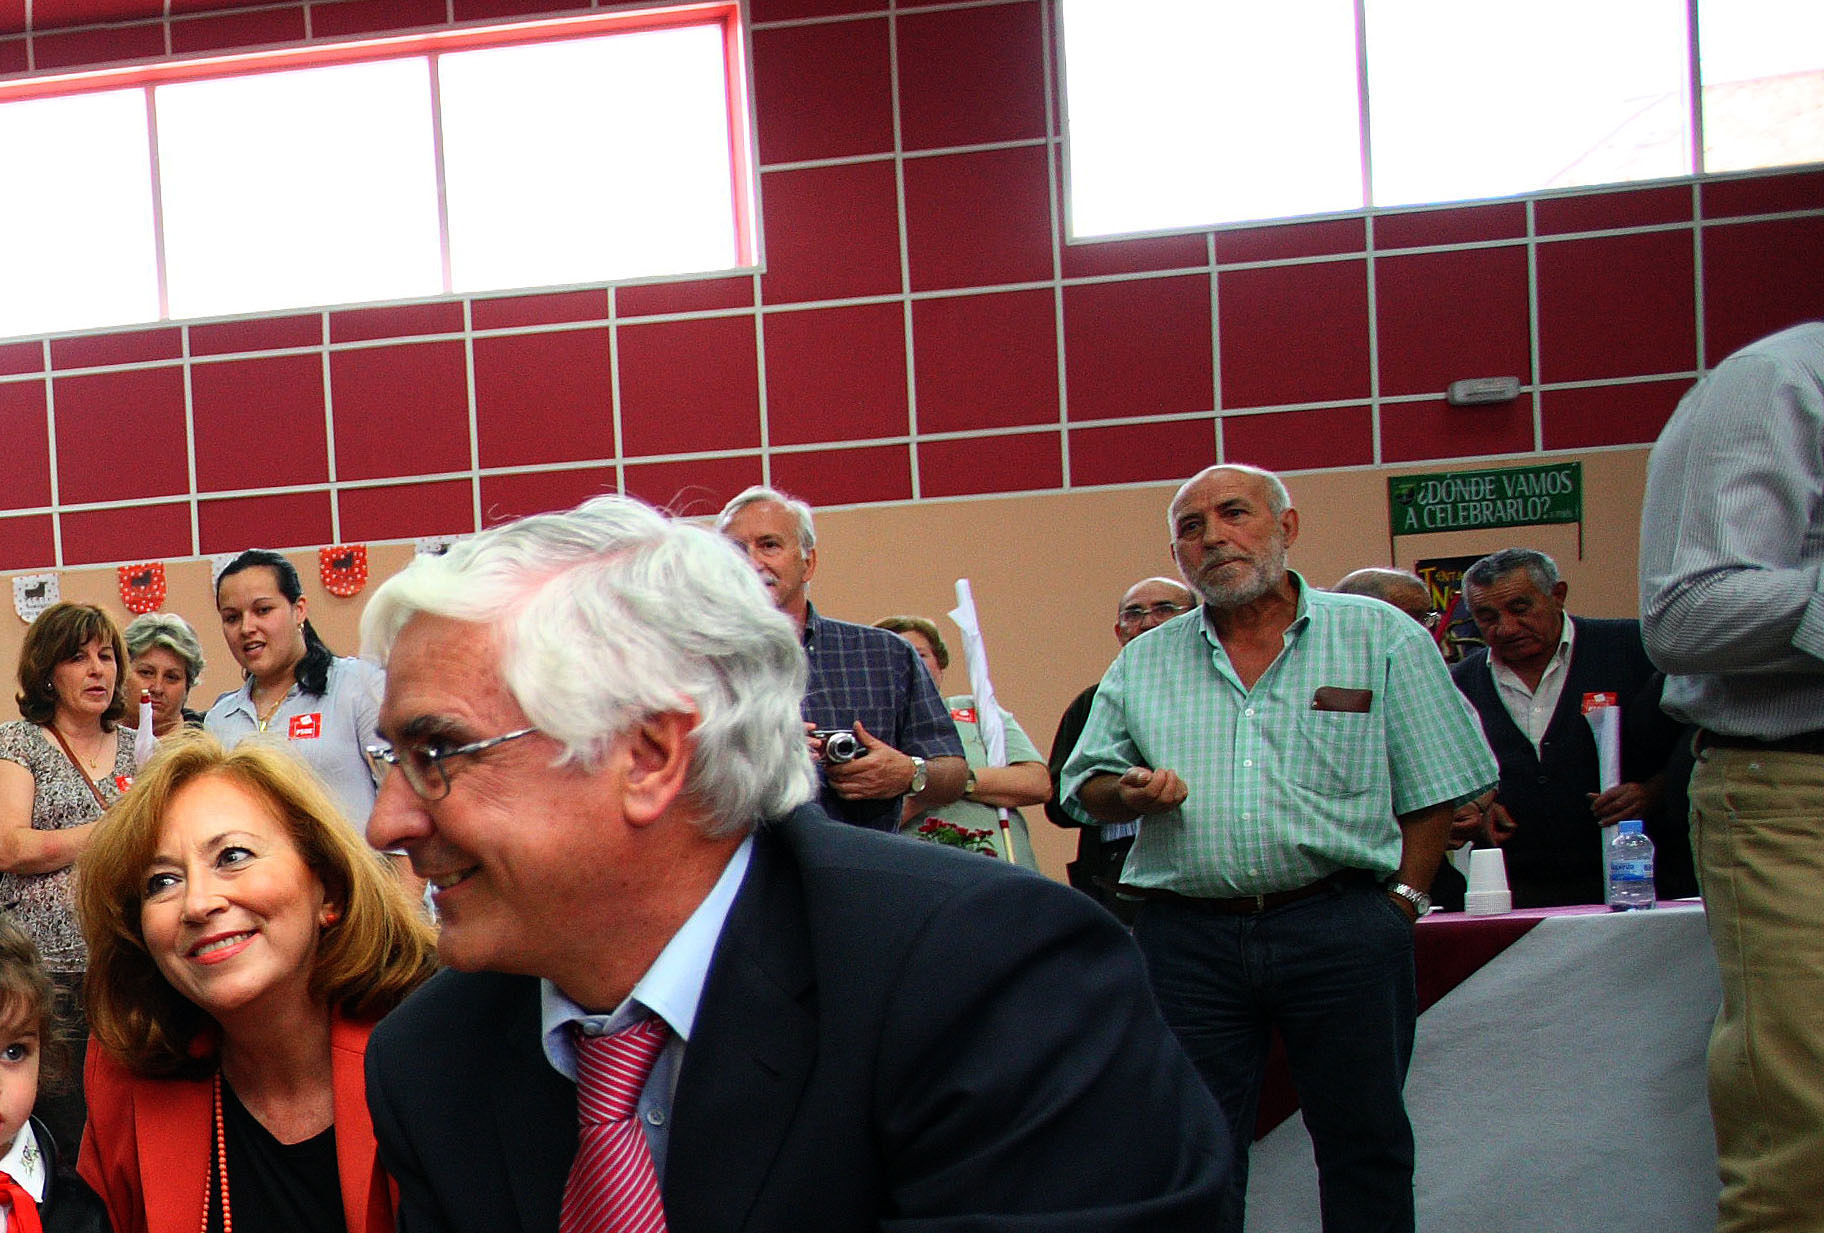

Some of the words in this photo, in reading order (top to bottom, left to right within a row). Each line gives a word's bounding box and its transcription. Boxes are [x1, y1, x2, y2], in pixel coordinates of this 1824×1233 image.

[1417, 473, 1497, 506] ¿DÓNDE
[1502, 470, 1573, 498] VAMOS
[1405, 507, 1418, 530] A
[1423, 496, 1551, 529] CELEBRARLO?
